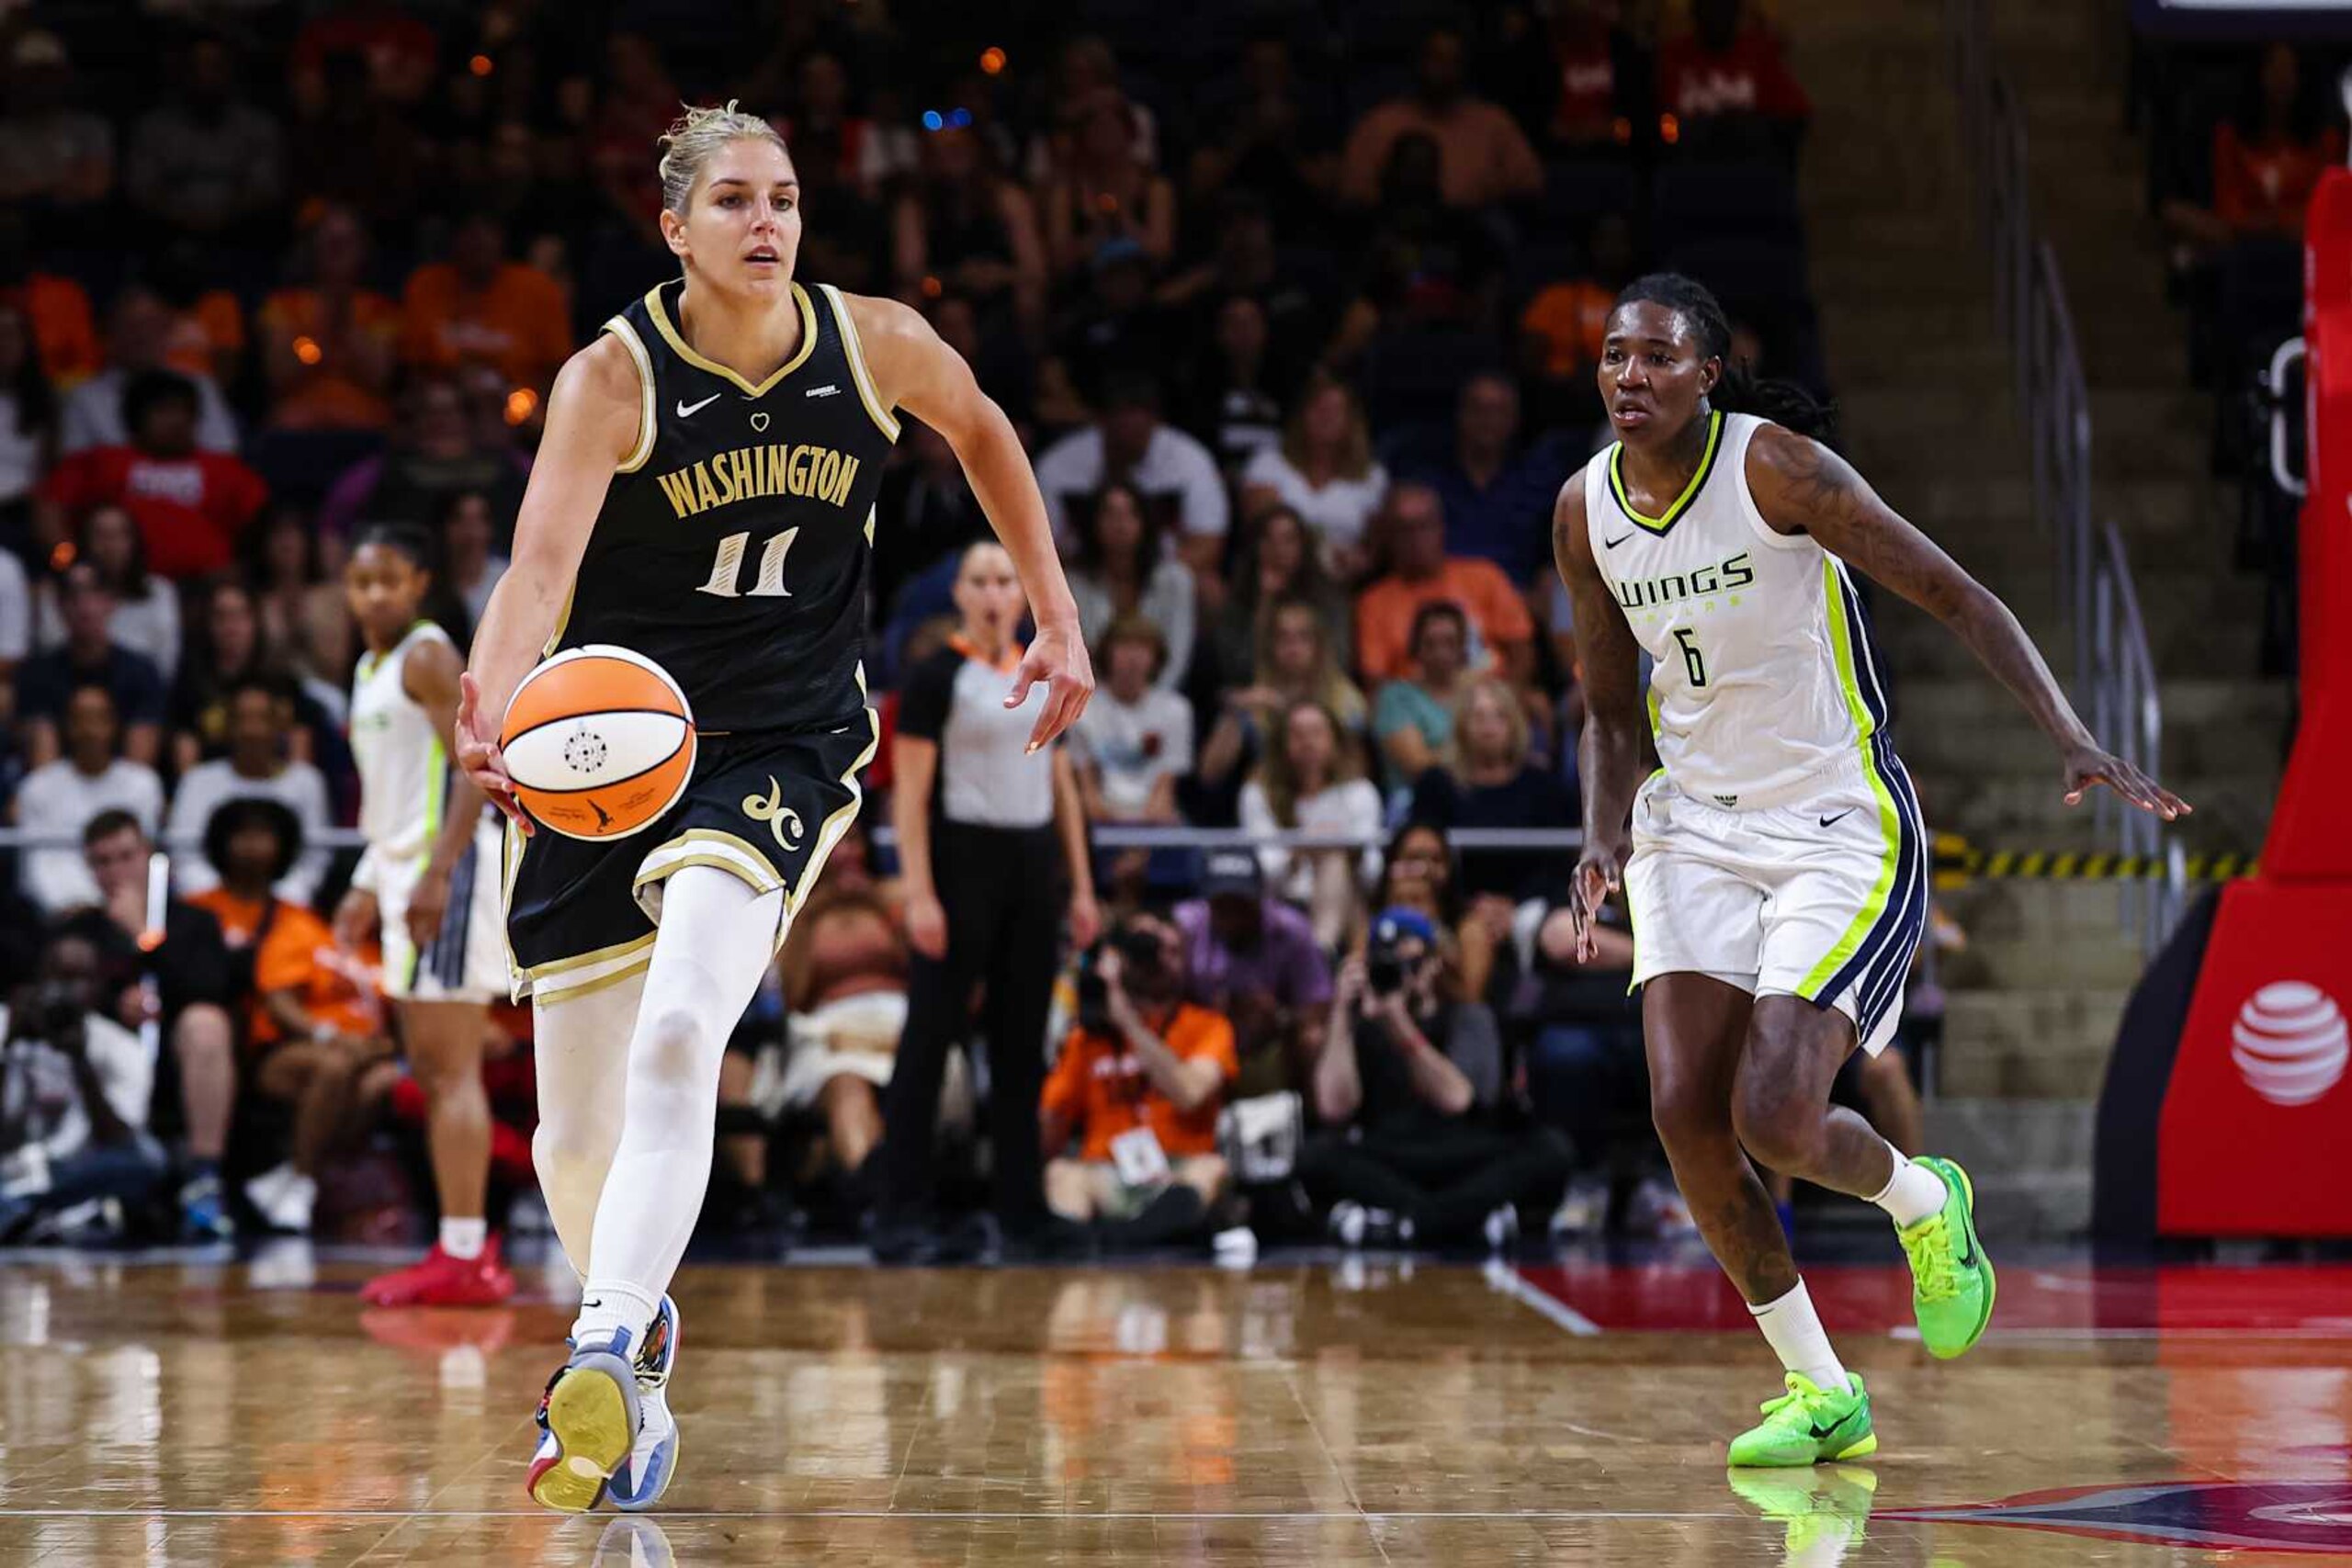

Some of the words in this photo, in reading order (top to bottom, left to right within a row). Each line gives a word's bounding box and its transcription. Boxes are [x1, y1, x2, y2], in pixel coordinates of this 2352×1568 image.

[657, 445, 860, 519] WASHINGTON
[695, 526, 799, 597] 11
[1673, 628, 1707, 687] 6
